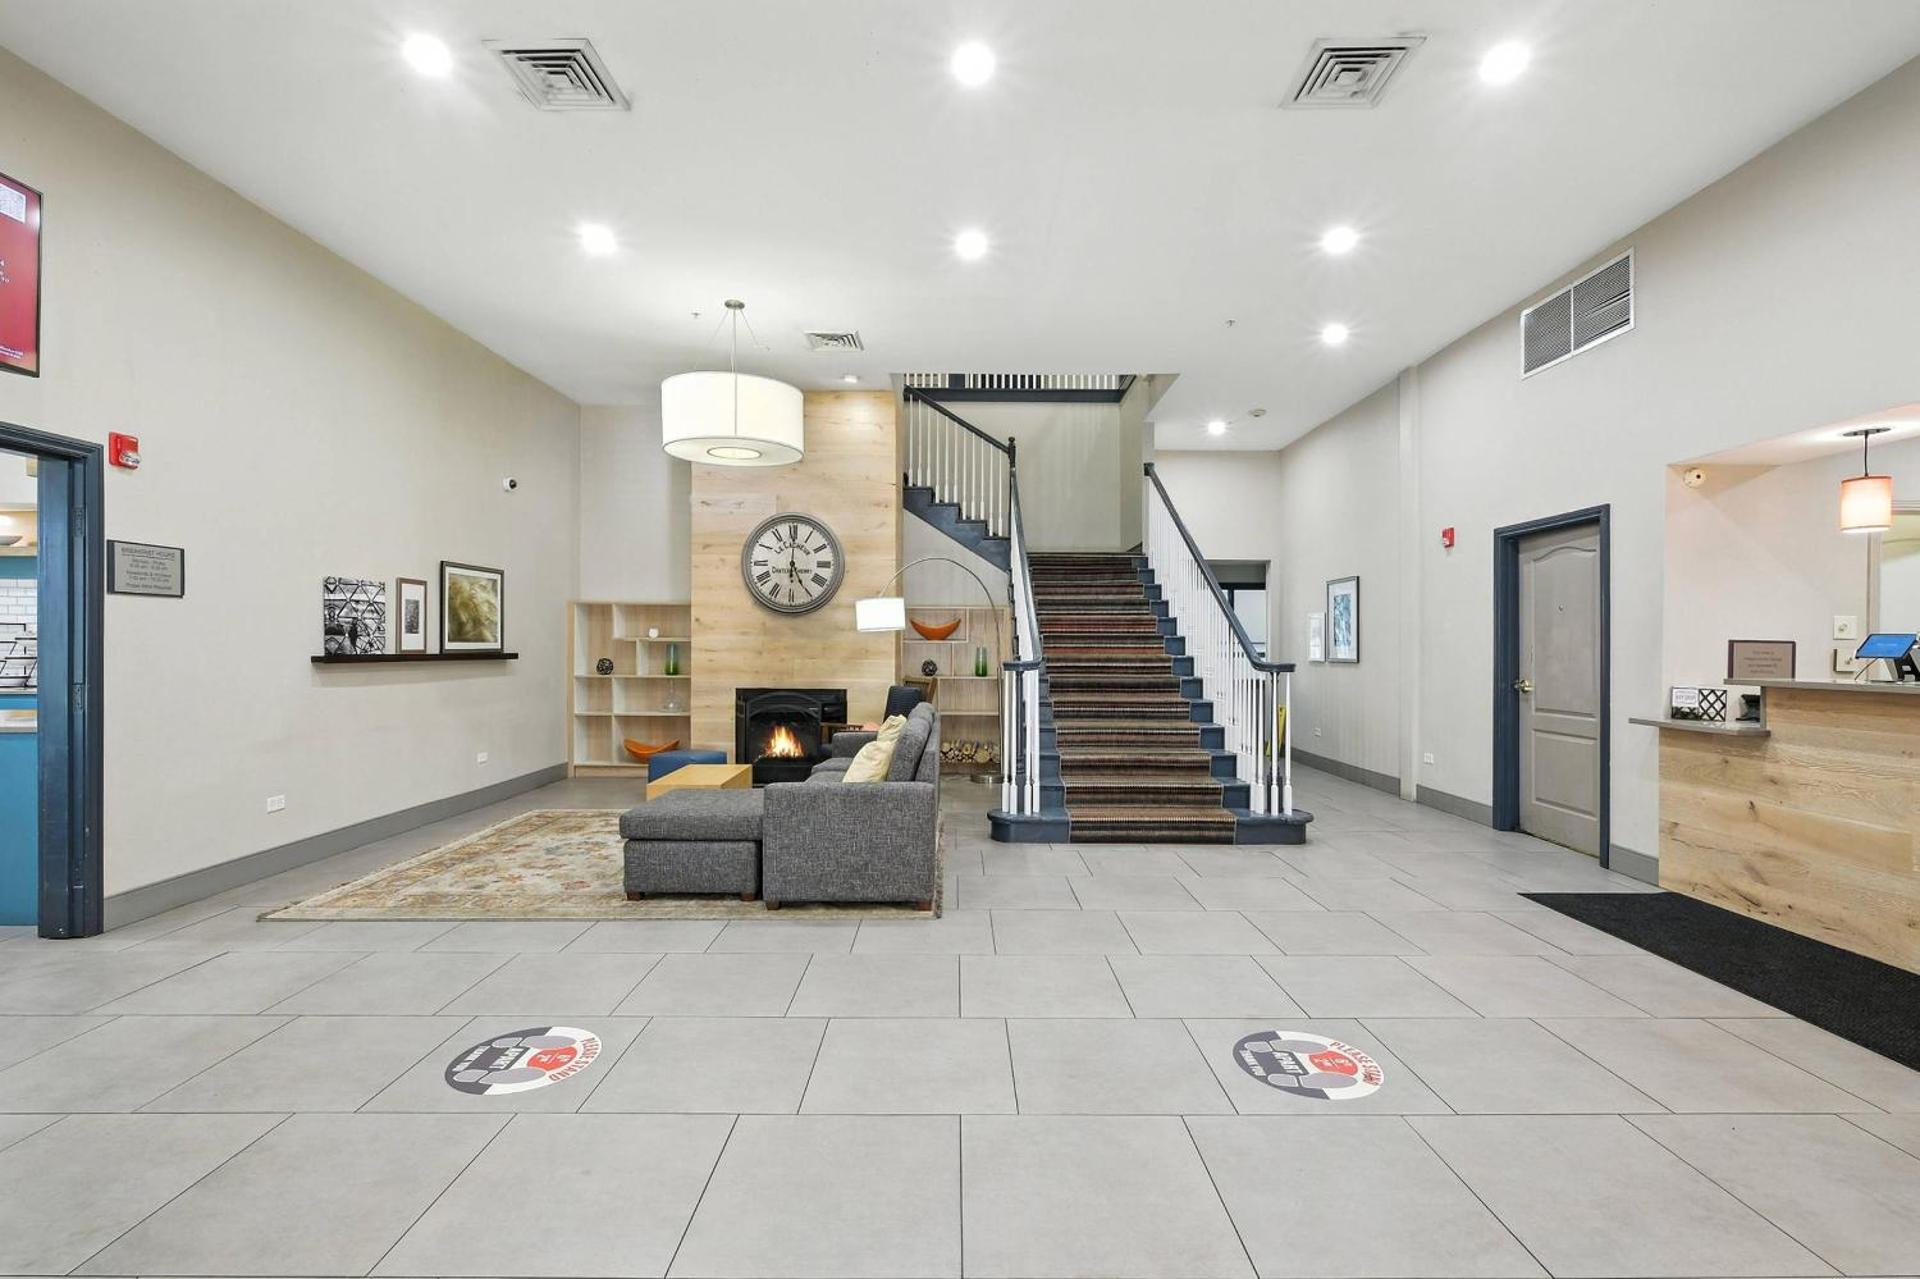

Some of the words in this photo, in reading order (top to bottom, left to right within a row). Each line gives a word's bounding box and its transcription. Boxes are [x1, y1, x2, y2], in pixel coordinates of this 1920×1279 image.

[489, 1047, 524, 1069] APART
[580, 1037, 599, 1060] PLEASE
[1329, 1041, 1374, 1064] PLEASE
[549, 1059, 590, 1081] STAND
[1272, 1052, 1303, 1074] APART
